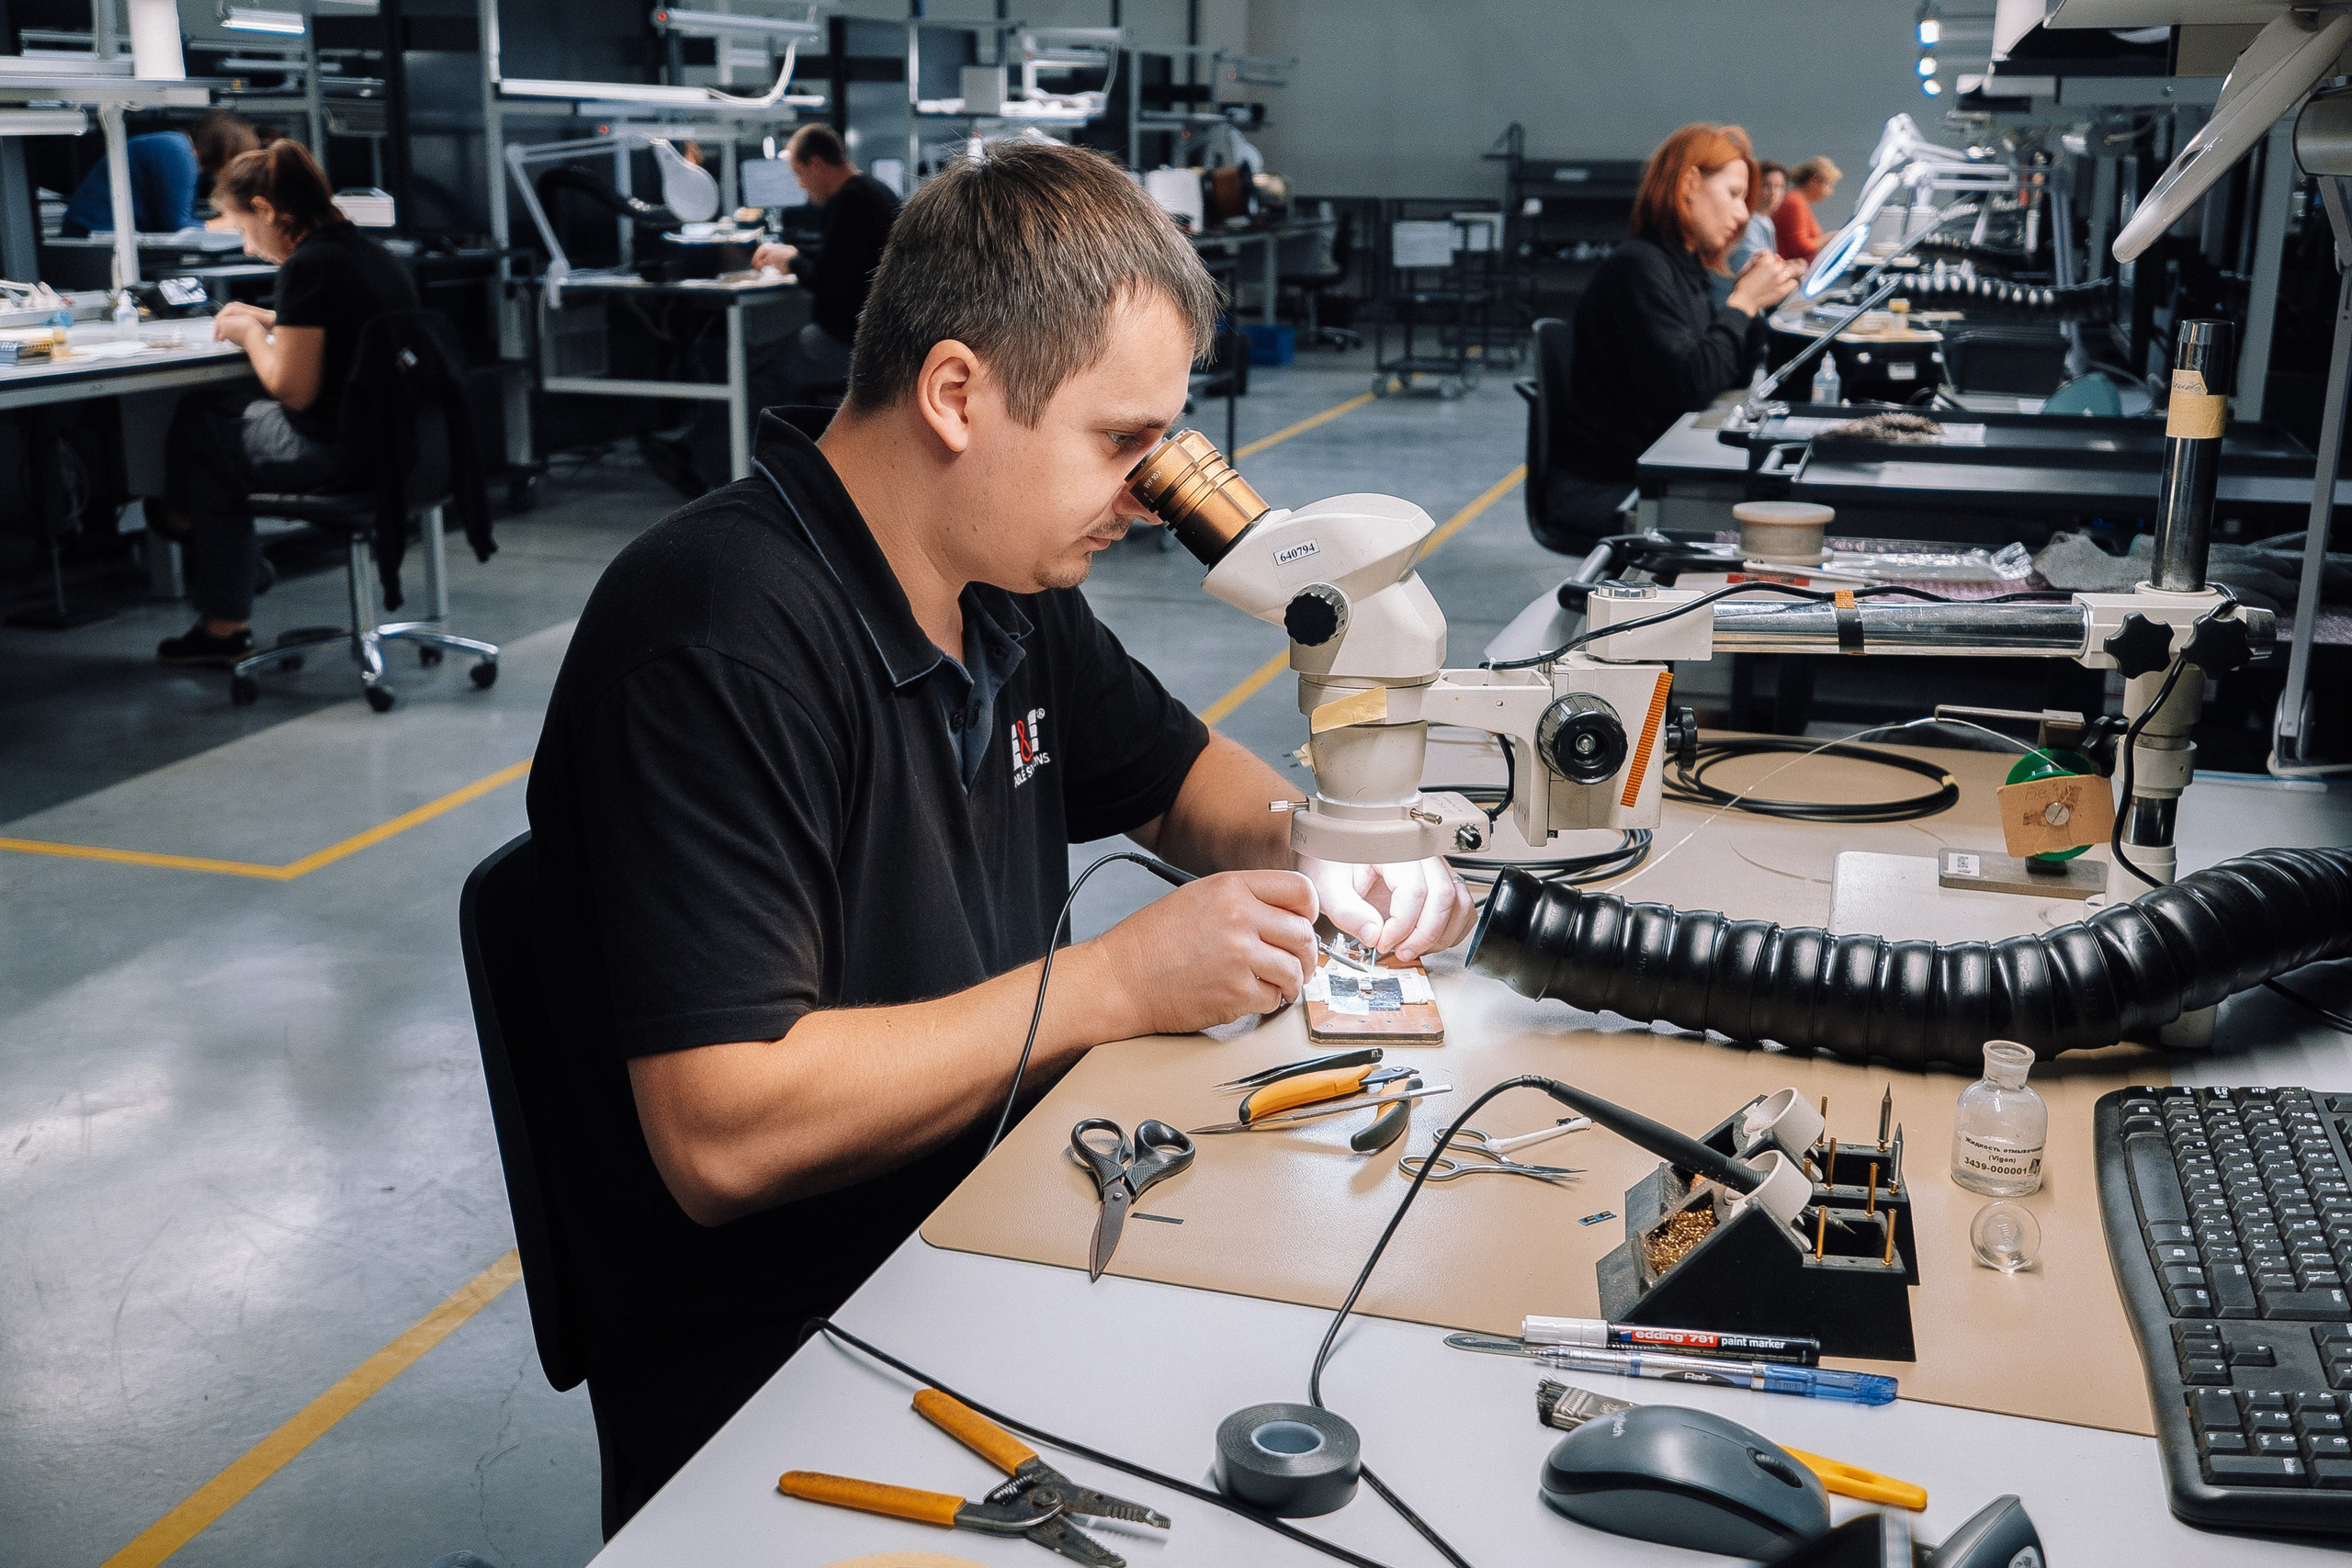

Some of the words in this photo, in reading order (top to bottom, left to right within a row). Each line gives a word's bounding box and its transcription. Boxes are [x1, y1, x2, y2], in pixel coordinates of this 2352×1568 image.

[1280, 543, 1315, 562] 640794
[1964, 1135, 2001, 1153] Жидкость
[1964, 1156, 2028, 1175] 3439-000001
[1988, 1154, 2017, 1164] (Vigon)
[1634, 1330, 1685, 1343] edding
[1688, 1334, 1714, 1344] 791
[1721, 1336, 1747, 1347] paint
[1748, 1338, 1786, 1349] marker
[1684, 1371, 1712, 1382] Flair
